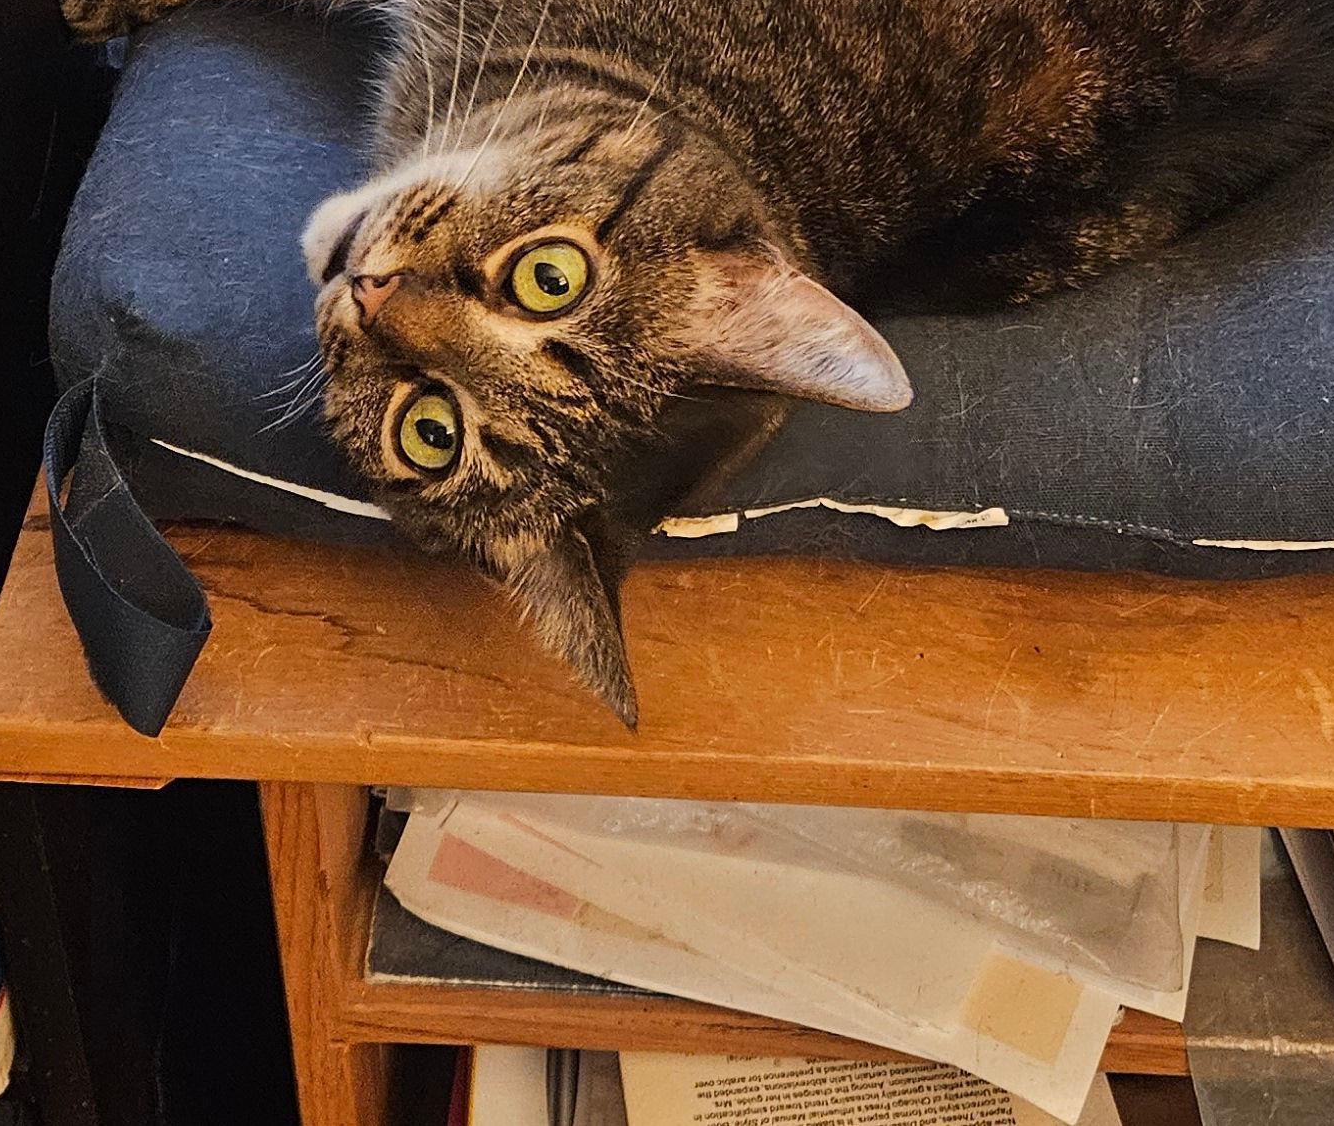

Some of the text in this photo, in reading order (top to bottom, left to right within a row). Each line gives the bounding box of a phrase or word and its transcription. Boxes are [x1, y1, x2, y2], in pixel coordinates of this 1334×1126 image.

[763, 1066, 814, 1081] preference
[824, 1062, 869, 1075] explained
[890, 1064, 937, 1076] eliminated
[748, 1075, 762, 1083] for
[828, 1074, 853, 1084] Latin
[854, 1070, 887, 1081] certain
[694, 1080, 715, 1089] over
[716, 1076, 746, 1087] arabic
[851, 1081, 884, 1091] Among
[713, 1085, 760, 1098] expanded
[834, 1086, 849, 1094] the
[881, 1085, 924, 1098] generally
[934, 1082, 963, 1092] reflect
[697, 1091, 712, 1100] the
[783, 1093, 791, 1101] in
[793, 1088, 833, 1099] changes
[944, 1089, 991, 1100] University
[766, 1095, 781, 1103] her
[830, 1093, 879, 1105] increasing
[892, 1096, 930, 1107] Chicago
[961, 1098, 996, 1110] correct
[770, 1103, 802, 1114] toward
[804, 1100, 829, 1109] trend
[857, 1102, 890, 1113] Press's
[939, 1104, 960, 1113] style
[705, 1107, 767, 1120] simplification
[808, 1107, 855, 1119] influential
[892, 1109, 922, 1119] formal
[924, 1107, 937, 1115] for
[694, 1114, 702, 1122] in
[771, 1114, 806, 1124] Manual
[920, 1118, 937, 1126] and
